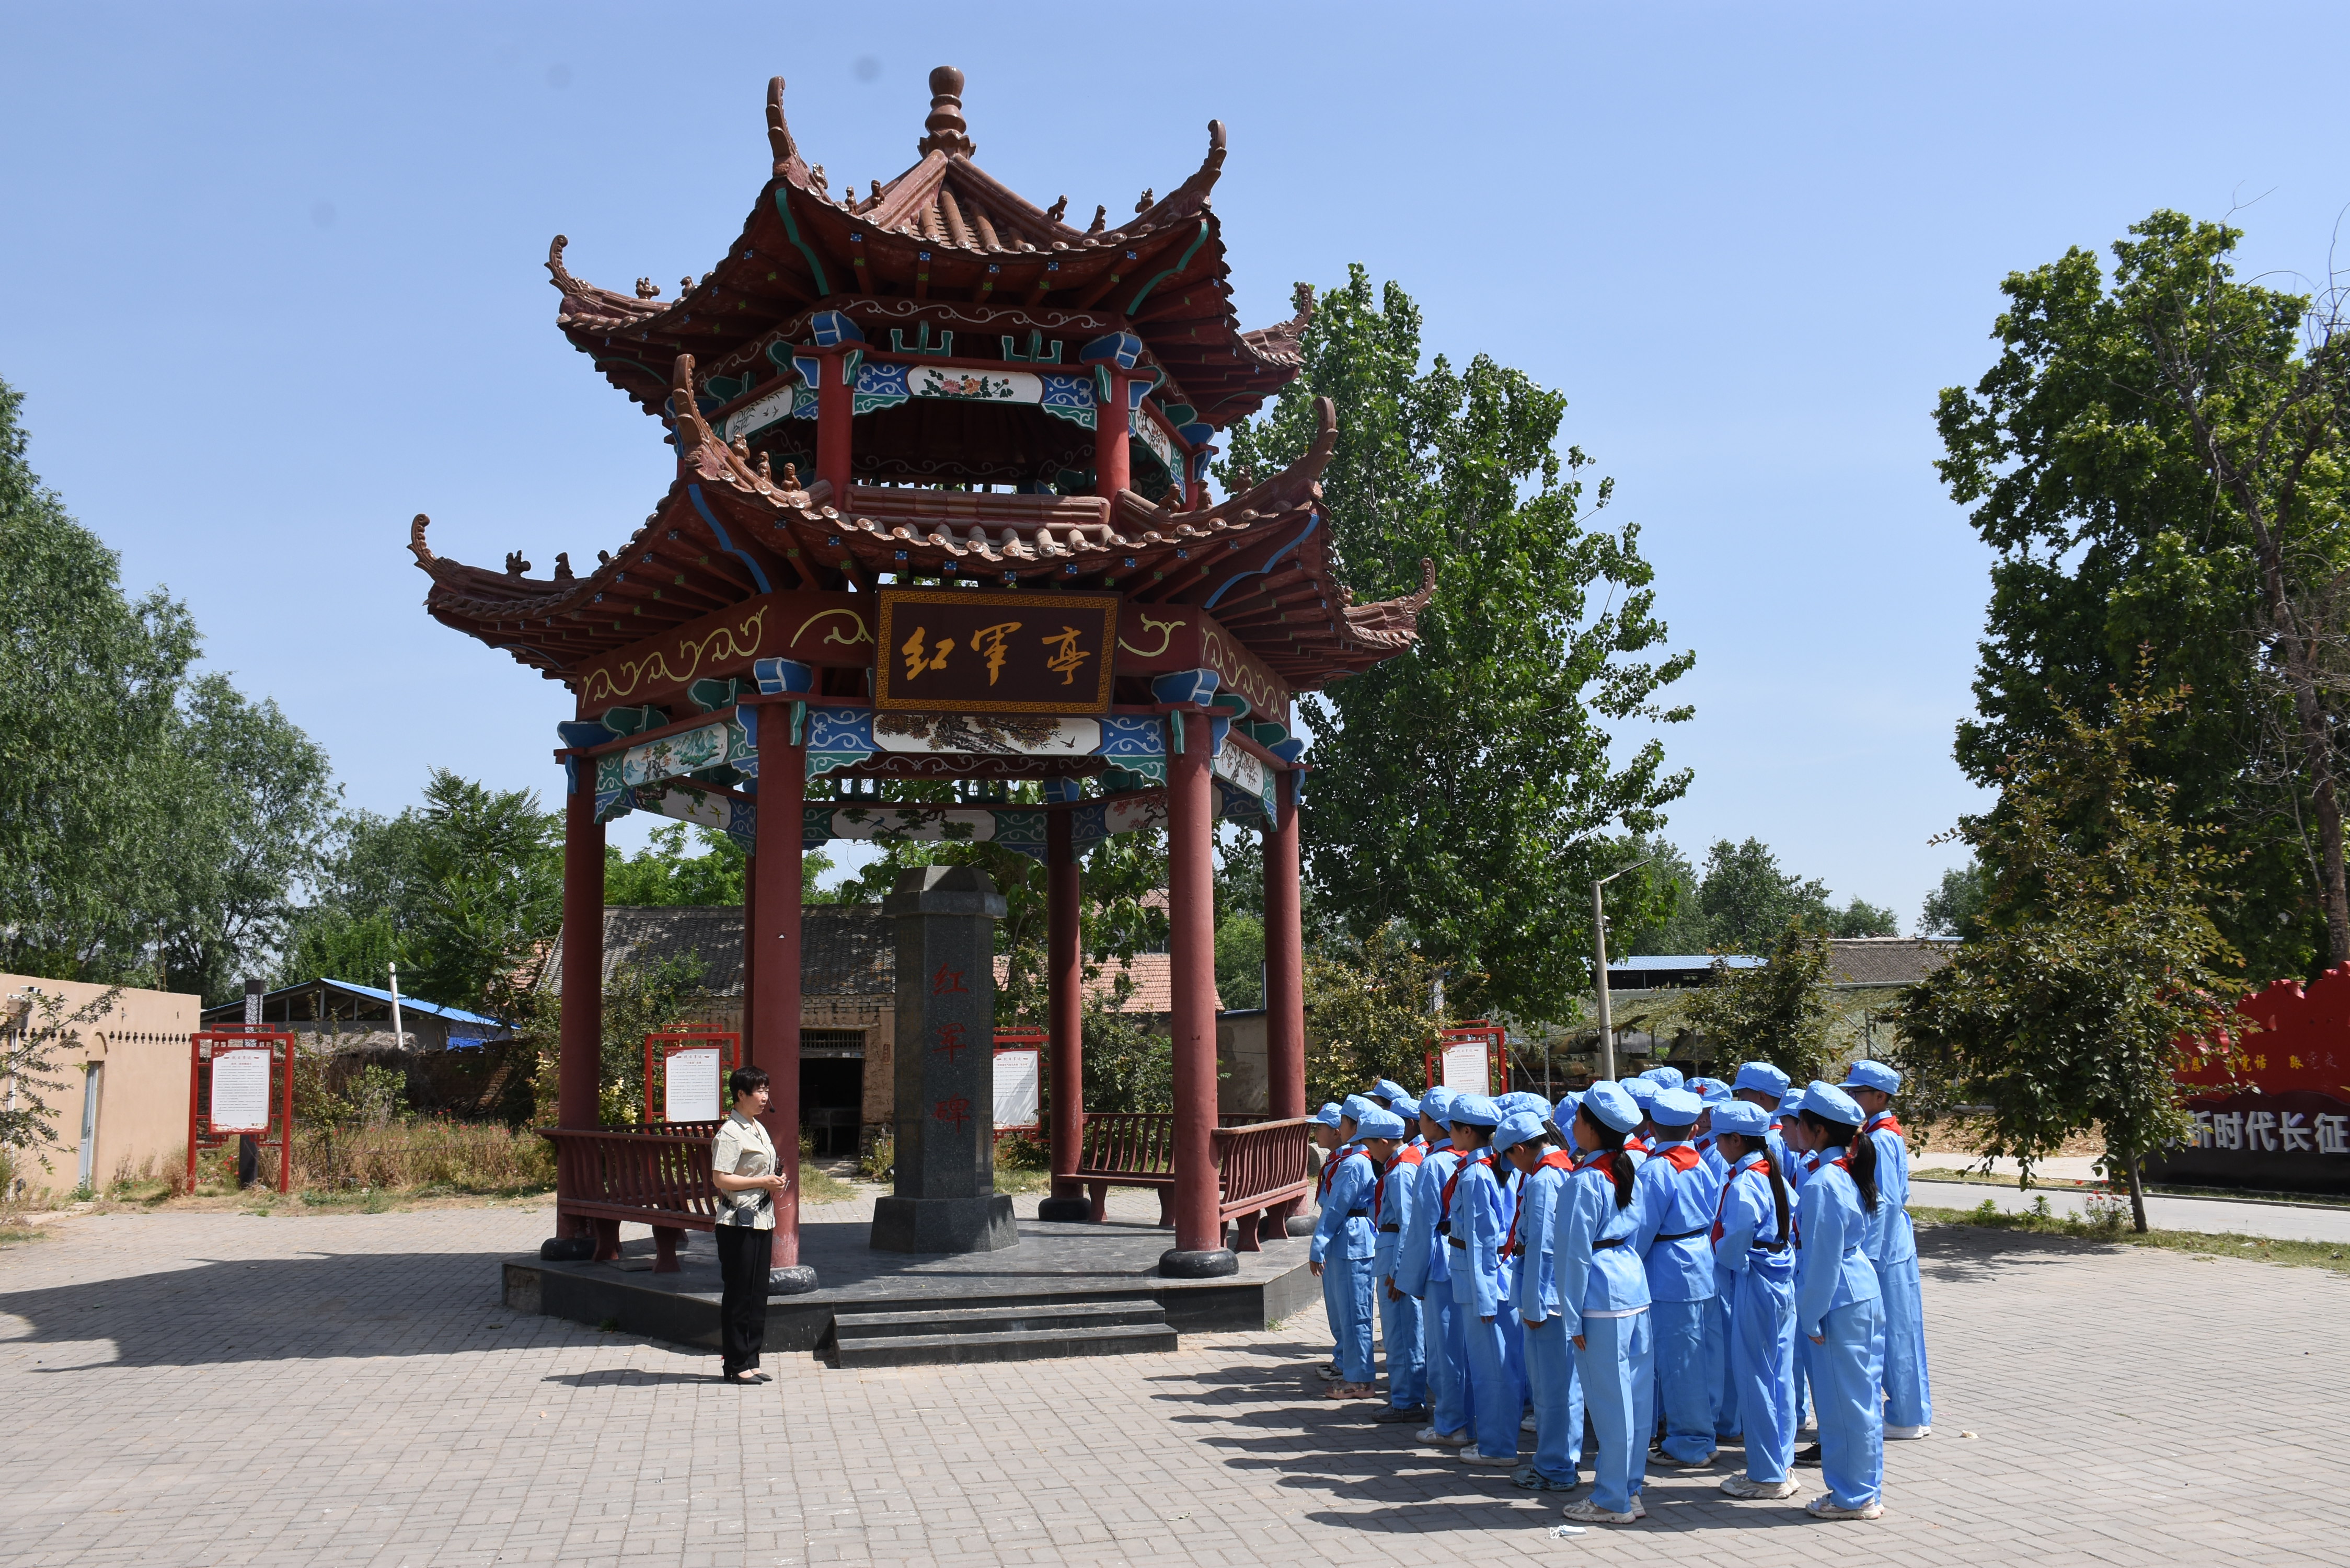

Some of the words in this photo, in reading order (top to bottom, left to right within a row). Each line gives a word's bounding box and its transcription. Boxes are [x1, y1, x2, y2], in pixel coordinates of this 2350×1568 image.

[902, 621, 1091, 686] 红军亭
[932, 963, 970, 1133] 红军碑
